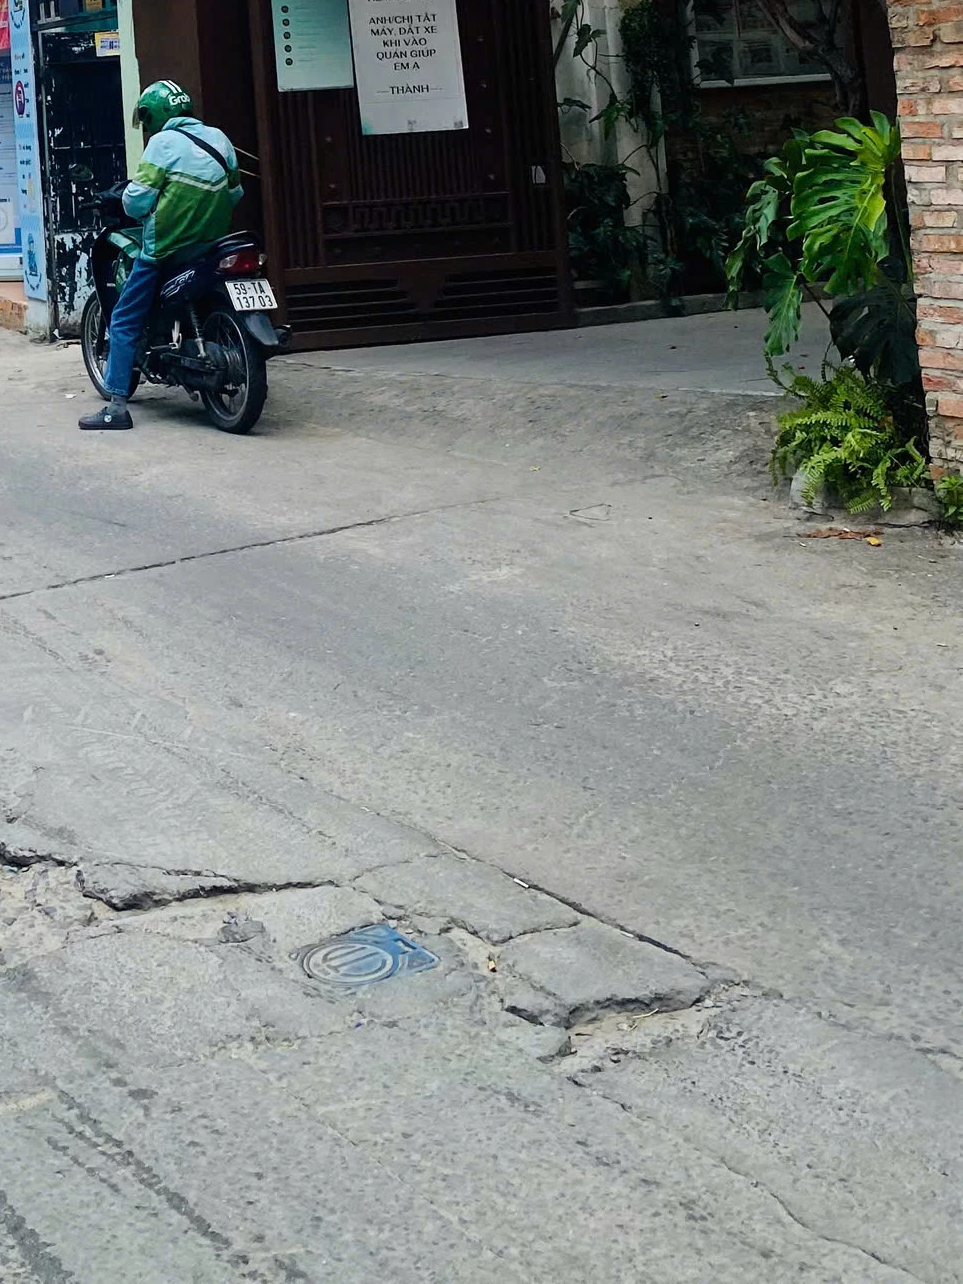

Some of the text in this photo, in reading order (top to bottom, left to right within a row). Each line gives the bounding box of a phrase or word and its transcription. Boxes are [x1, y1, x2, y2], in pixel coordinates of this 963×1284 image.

[423, 25, 438, 34] XE
[382, 36, 428, 48] KHI VÀO
[410, 47, 437, 59] GIÚP
[393, 62, 410, 71] EM
[389, 83, 430, 95] THÀNH
[169, 92, 191, 106] Grab
[233, 281, 266, 296] 59-TA
